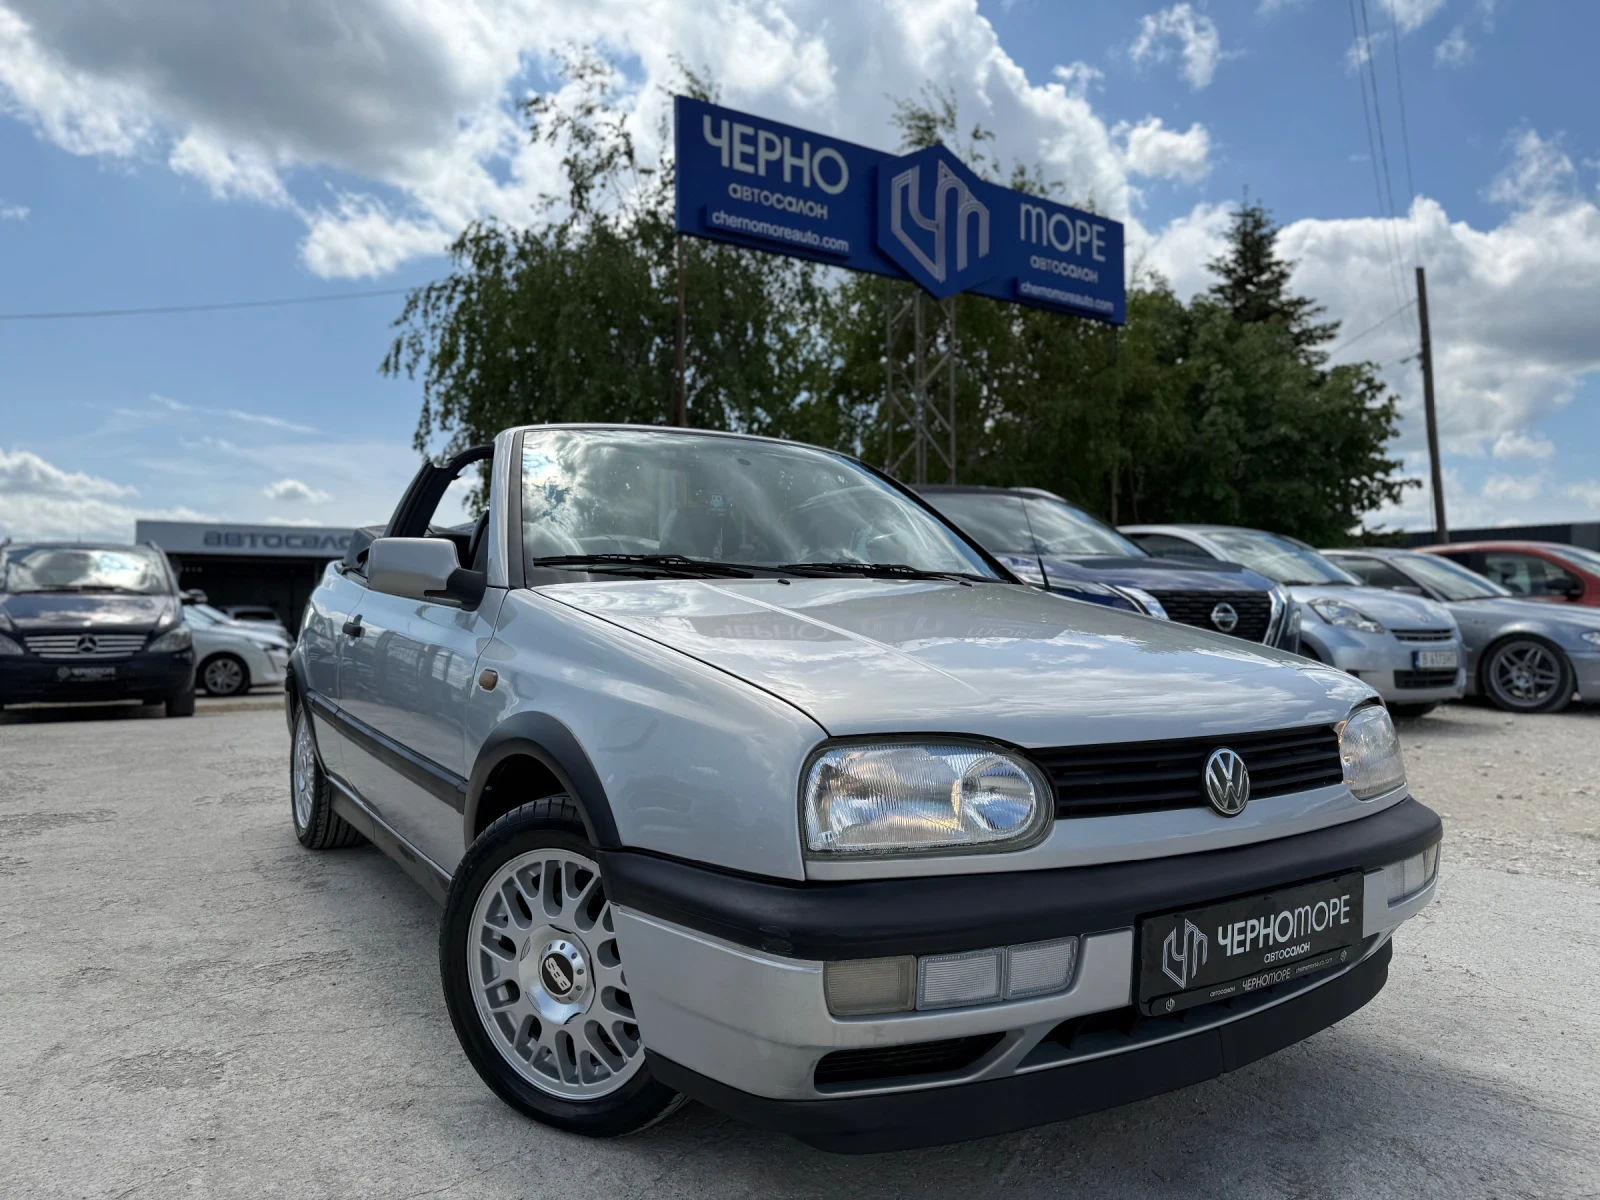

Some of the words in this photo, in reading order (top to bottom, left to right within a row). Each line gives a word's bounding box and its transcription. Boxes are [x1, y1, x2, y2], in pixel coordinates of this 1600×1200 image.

[703, 114, 849, 195] ЧЕРНО
[728, 183, 829, 220] автосалон
[712, 210, 849, 252] chernomoreauto.com
[1019, 202, 1107, 263] МОРЕ
[1030, 255, 1099, 284] автосалон
[1020, 281, 1115, 313] chernomoreauto.com
[1217, 894, 1350, 957] ЧЕРНОМОРЕ
[1264, 941, 1311, 964] автосалон
[1242, 968, 1291, 992] ЧЕРНОМОРЕ
